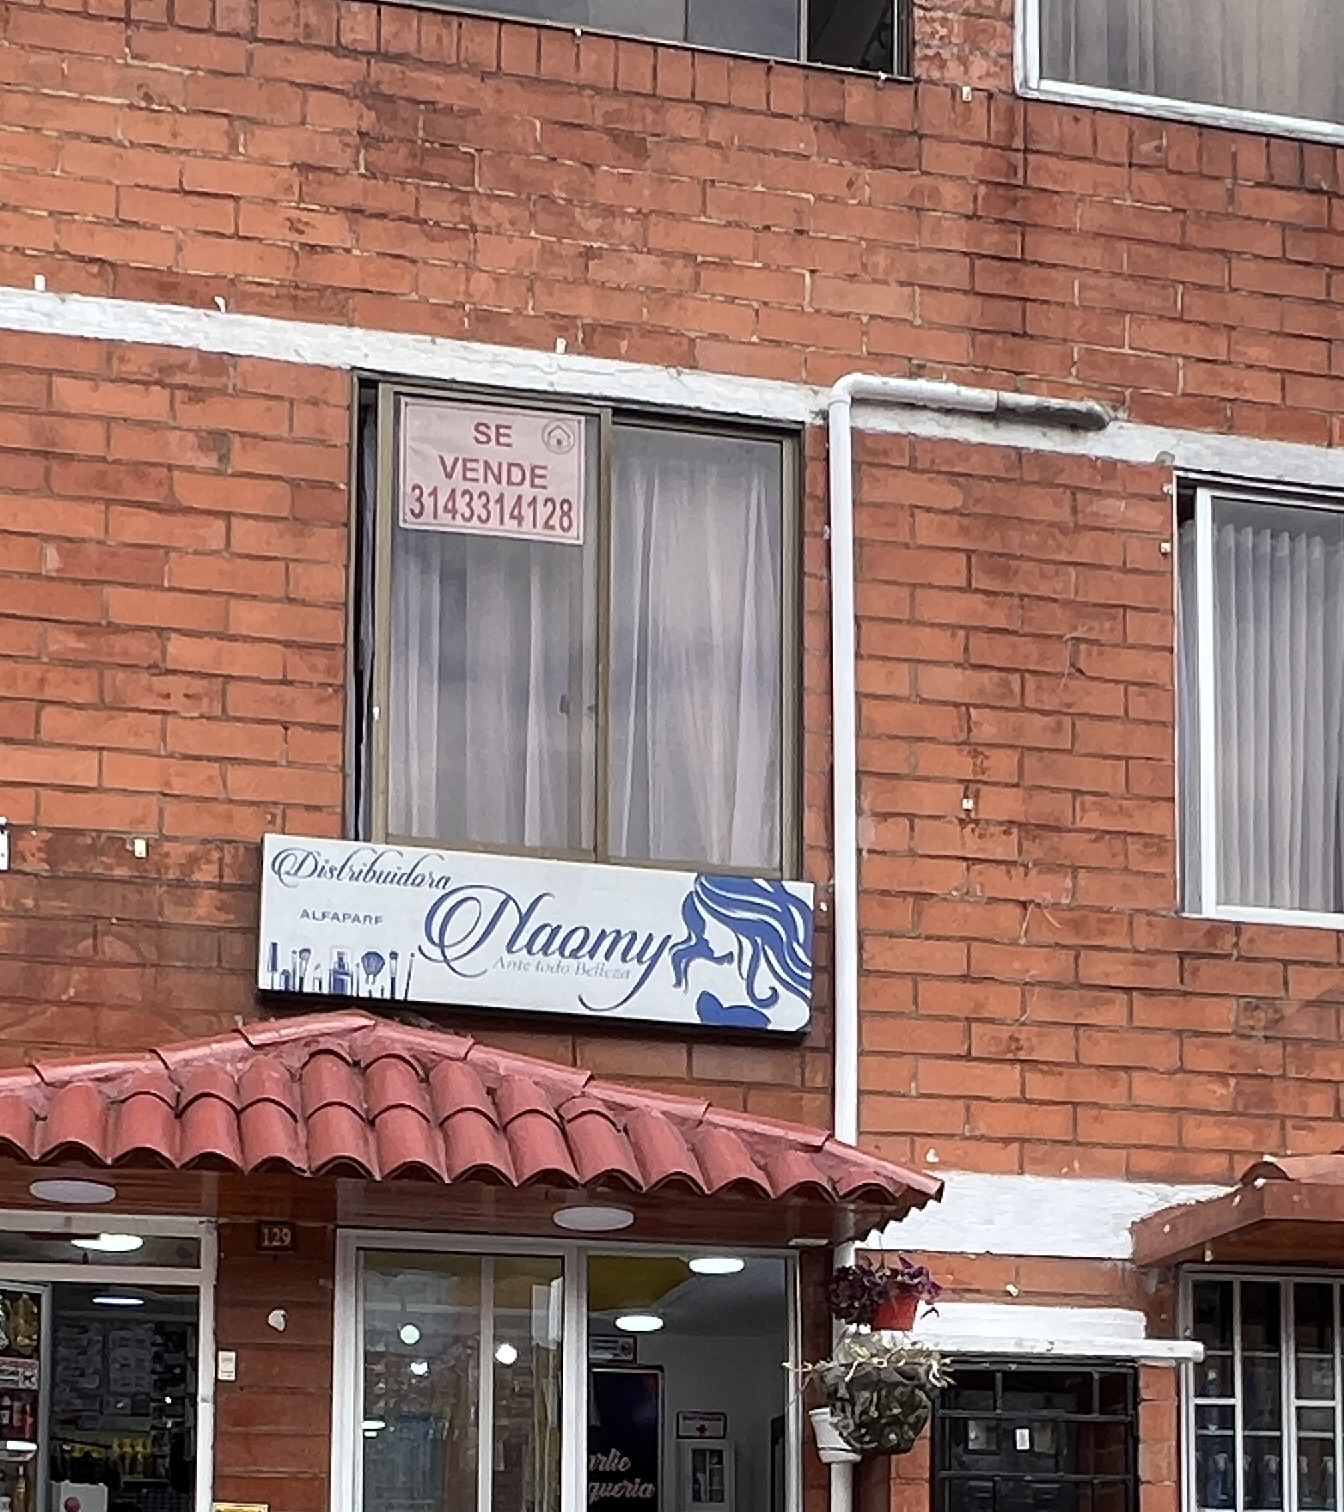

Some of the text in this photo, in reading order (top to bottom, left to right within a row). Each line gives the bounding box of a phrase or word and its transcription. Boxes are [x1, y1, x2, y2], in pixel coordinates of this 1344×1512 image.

[473, 421, 513, 448] SE
[438, 454, 548, 490] VENDE
[408, 483, 574, 534] 3143314128
[270, 847, 452, 890] Distribuidora
[418, 884, 672, 1012] Naomy
[262, 1227, 292, 1247] 129
